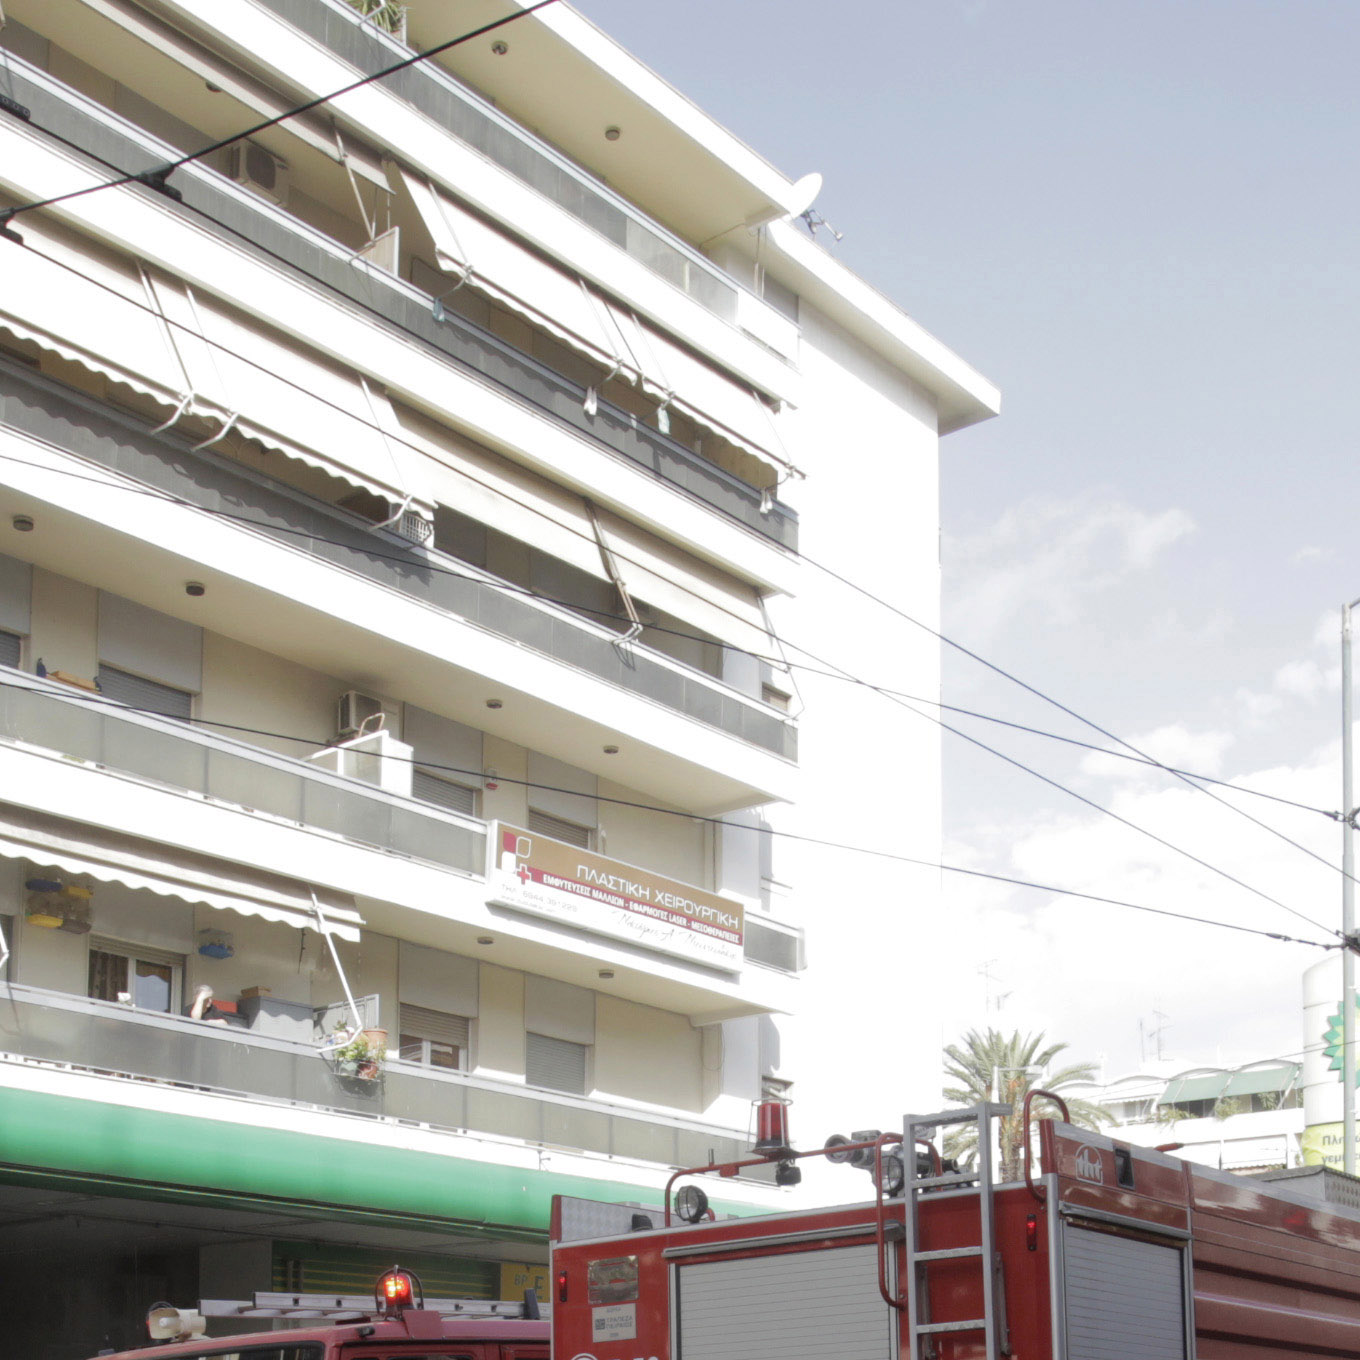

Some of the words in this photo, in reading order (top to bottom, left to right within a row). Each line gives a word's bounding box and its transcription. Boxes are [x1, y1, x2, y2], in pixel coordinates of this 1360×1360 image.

[576, 864, 650, 900] ΠΛΑΣΤΙΚΗ
[654, 889, 739, 929] ΧΕΙΡΟΥΡΓΙΚΗ
[592, 887, 624, 907] ΜΑΛΛΙΩΝ
[629, 899, 668, 921] ΕΦΑΡΜΟΓΕΣ
[668, 910, 687, 927] LASER
